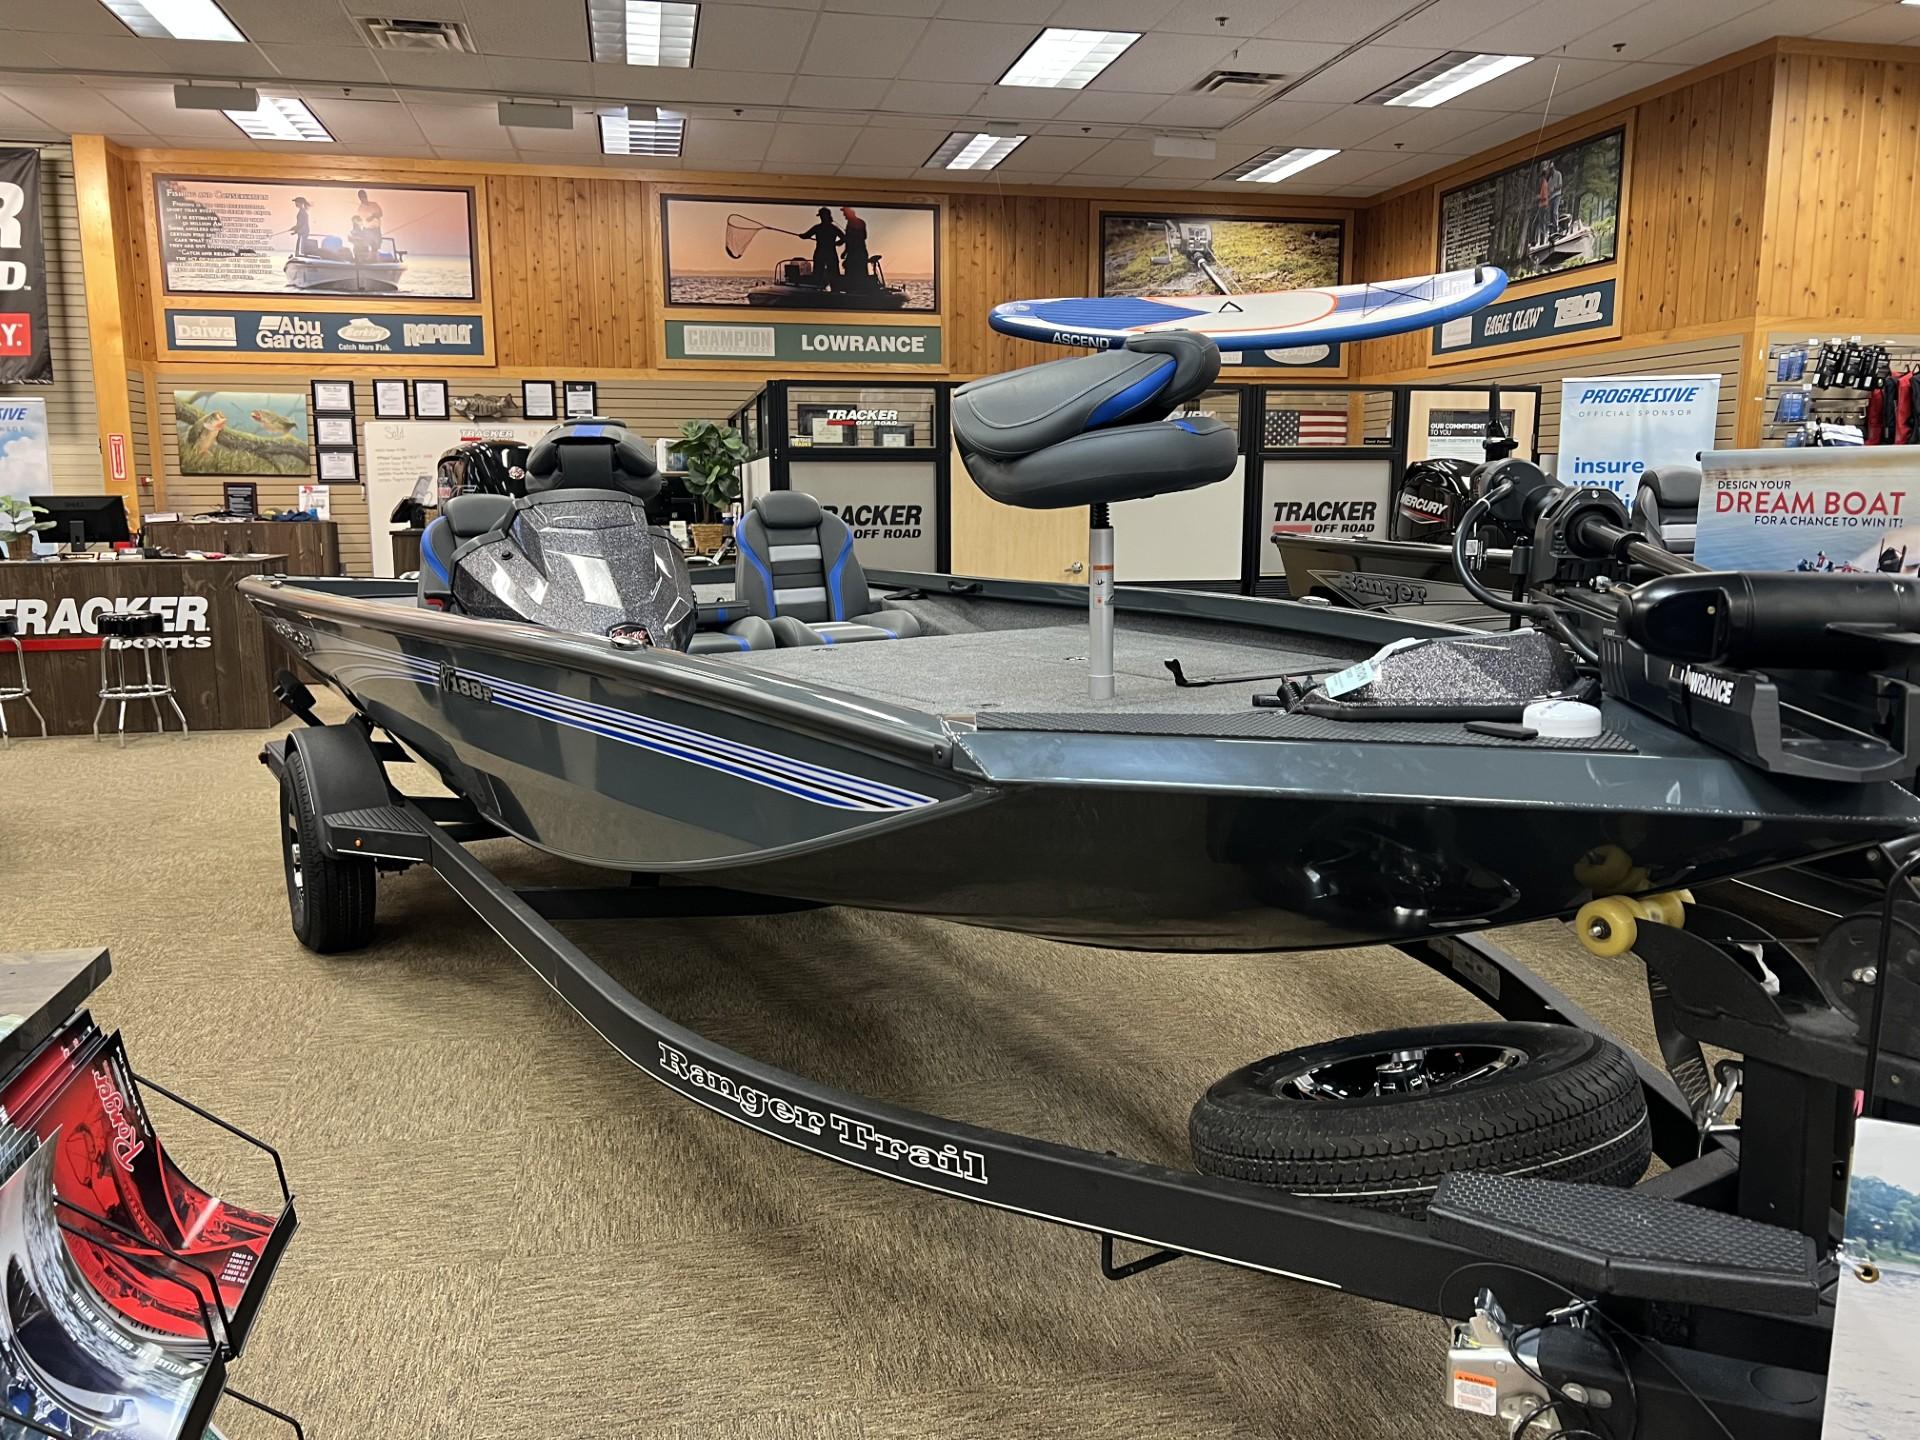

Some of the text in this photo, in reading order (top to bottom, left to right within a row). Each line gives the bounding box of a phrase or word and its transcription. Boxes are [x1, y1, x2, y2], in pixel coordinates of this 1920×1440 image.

[278, 317, 321, 334] Abu
[1484, 306, 1544, 337] EAGLE CLAW
[177, 324, 236, 339] Daiwa
[255, 331, 324, 349] Garcia
[688, 328, 772, 349] CHAMPION
[801, 334, 925, 353] LOWRANCE
[1052, 332, 1112, 349] ASCEND
[1580, 387, 1699, 404] PROGRESSIVE
[827, 409, 898, 420] TRACKER
[1578, 409, 1692, 418] OFFICIAL SPONSOR
[459, 429, 514, 439] TRACKER
[1430, 422, 1487, 431] OUR COMMITMENT
[1574, 457, 1645, 474] insure
[1717, 480, 1792, 490] DESIGN YOUR
[1273, 501, 1378, 522] TRACKER
[1400, 492, 1449, 516] MERCURY
[1715, 491, 1906, 516] DREAM BOAT
[821, 505, 922, 526] ACKER
[1754, 515, 1904, 529] FOR A CHANCE TO WIN IT!
[853, 529, 922, 539] OFF ROAD
[1313, 523, 1376, 534] OFF ROAD
[1340, 571, 1428, 605] Ranger
[91, 1068, 145, 1173] Ranger
[657, 1041, 989, 1185] Ranger Trail
[93, 1319, 135, 1351] CHAMPION
